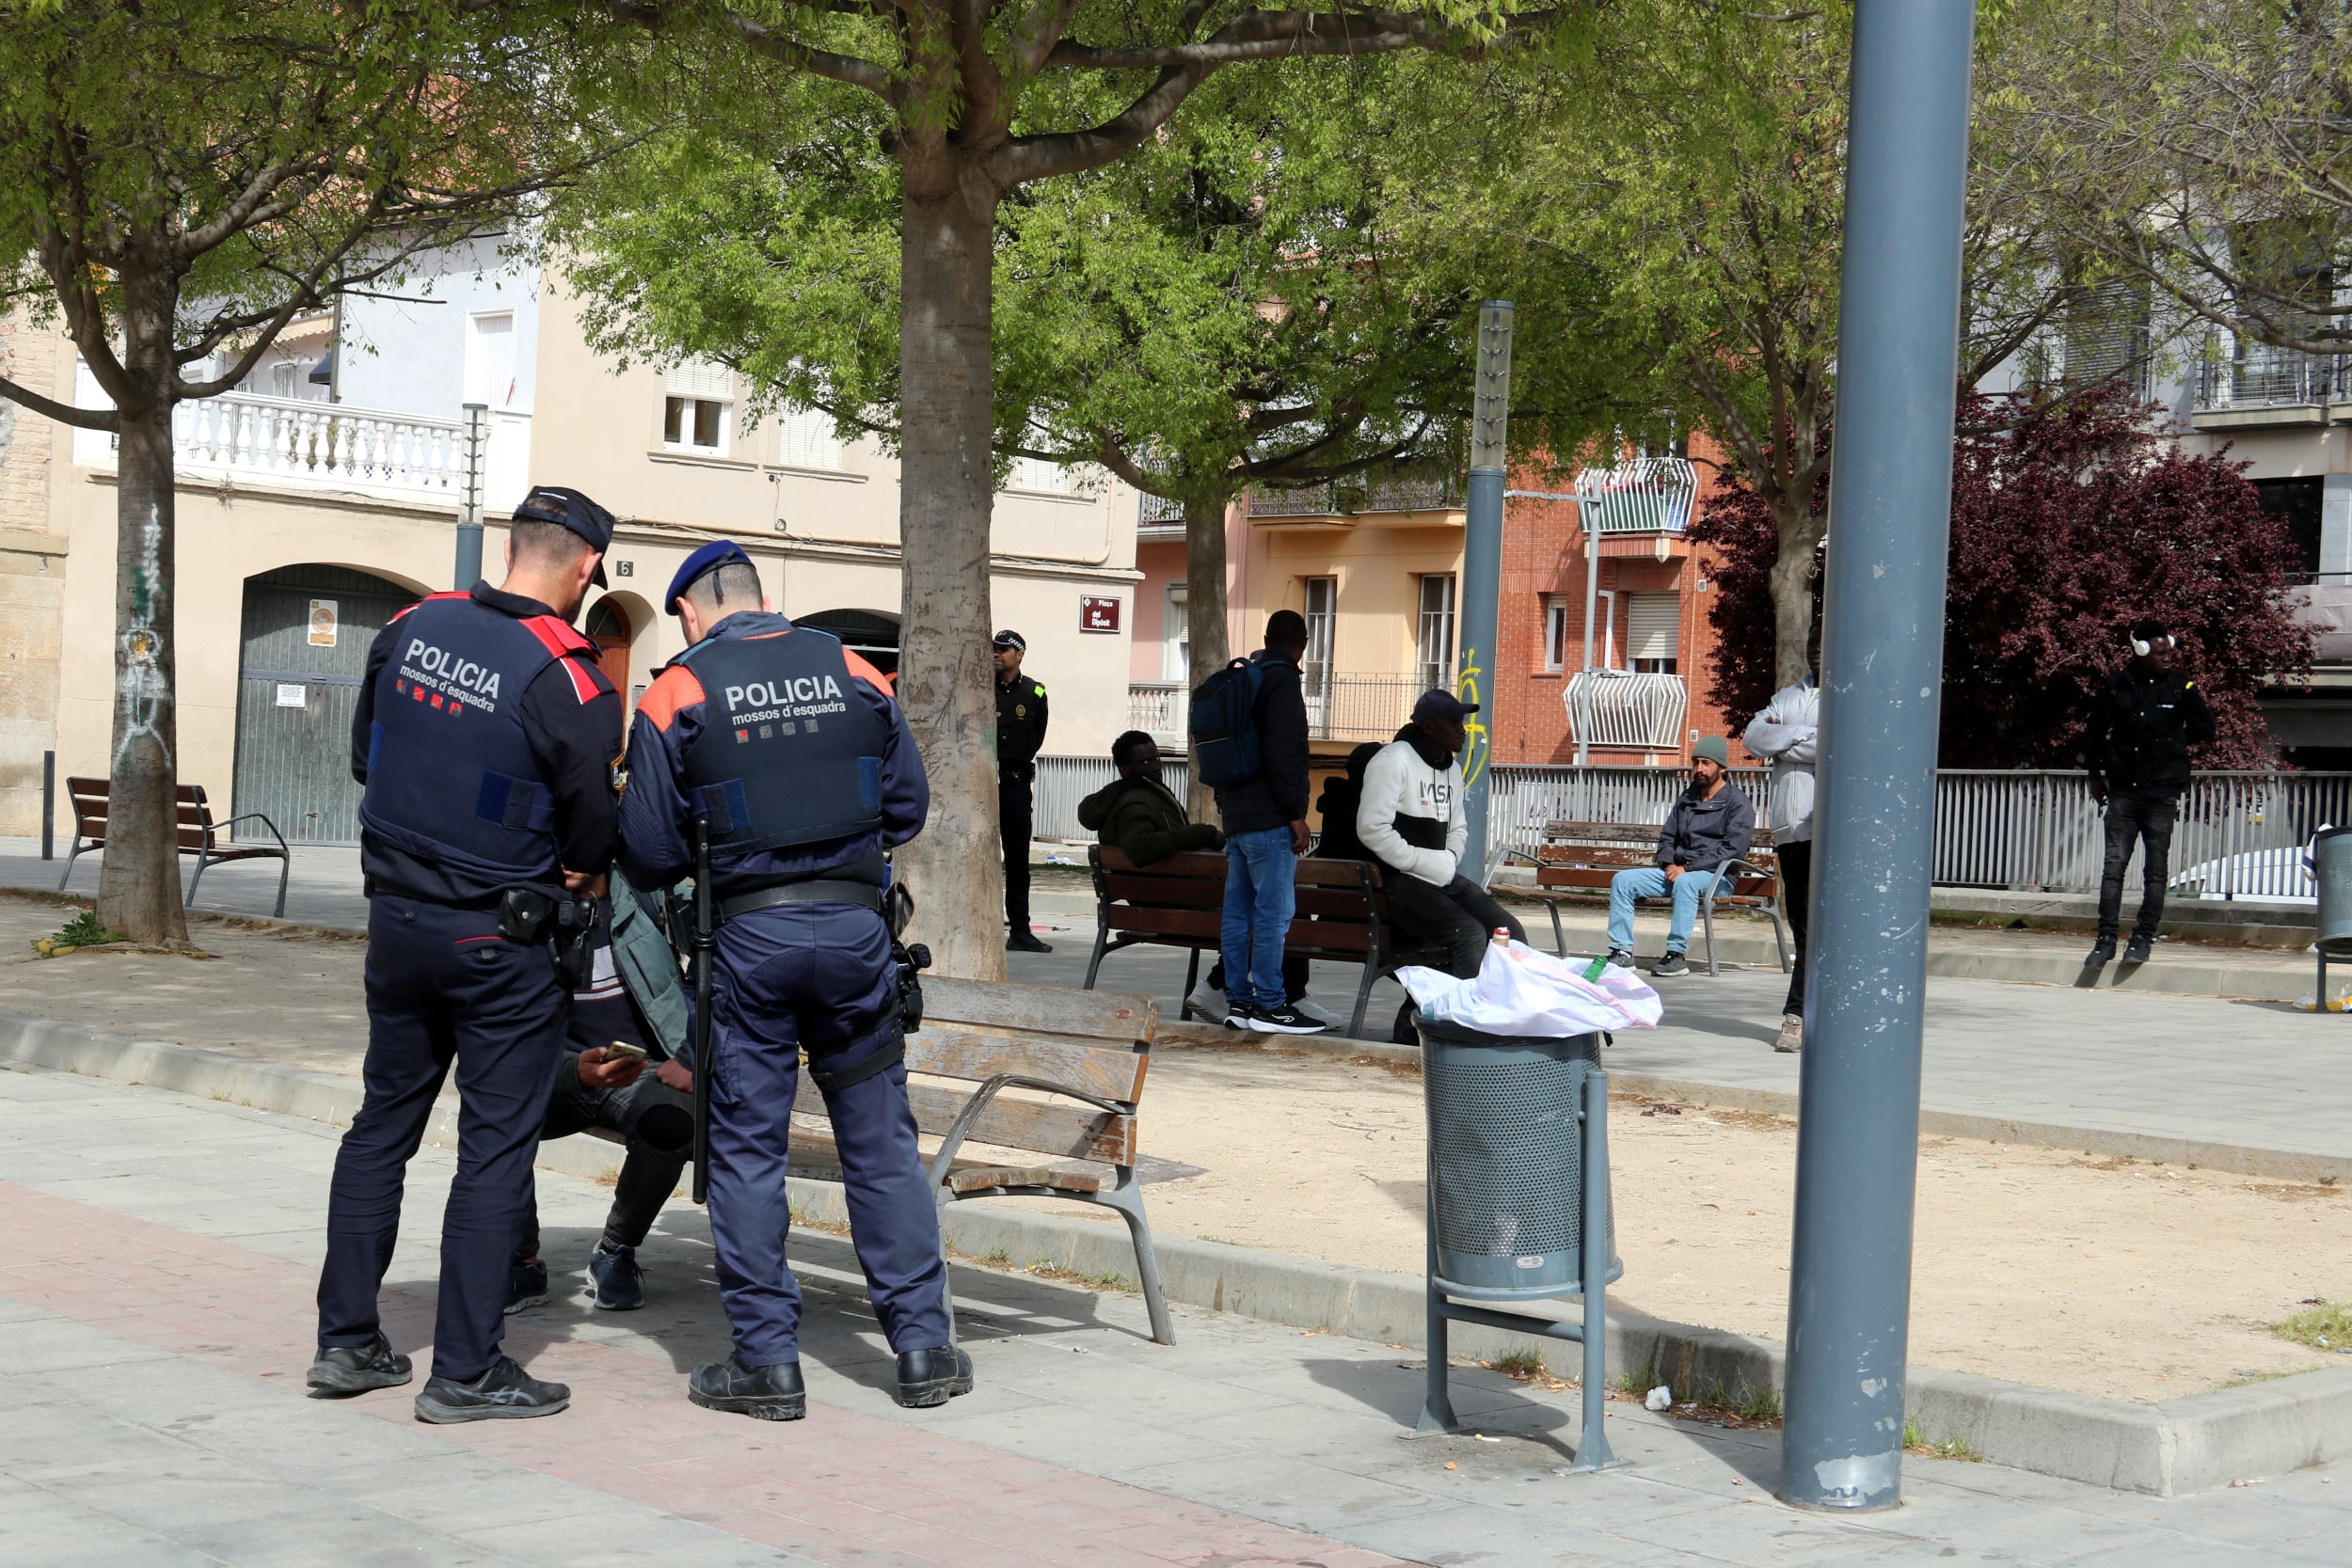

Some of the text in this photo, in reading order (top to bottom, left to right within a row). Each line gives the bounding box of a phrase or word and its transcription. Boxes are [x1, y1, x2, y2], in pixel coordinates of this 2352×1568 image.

[621, 562, 629, 576] 6
[1098, 599, 1113, 608] Plaça
[399, 665, 438, 689] mossos
[405, 638, 501, 700] POLICIA
[724, 675, 844, 711] POLICIA
[732, 709, 780, 726] mossos
